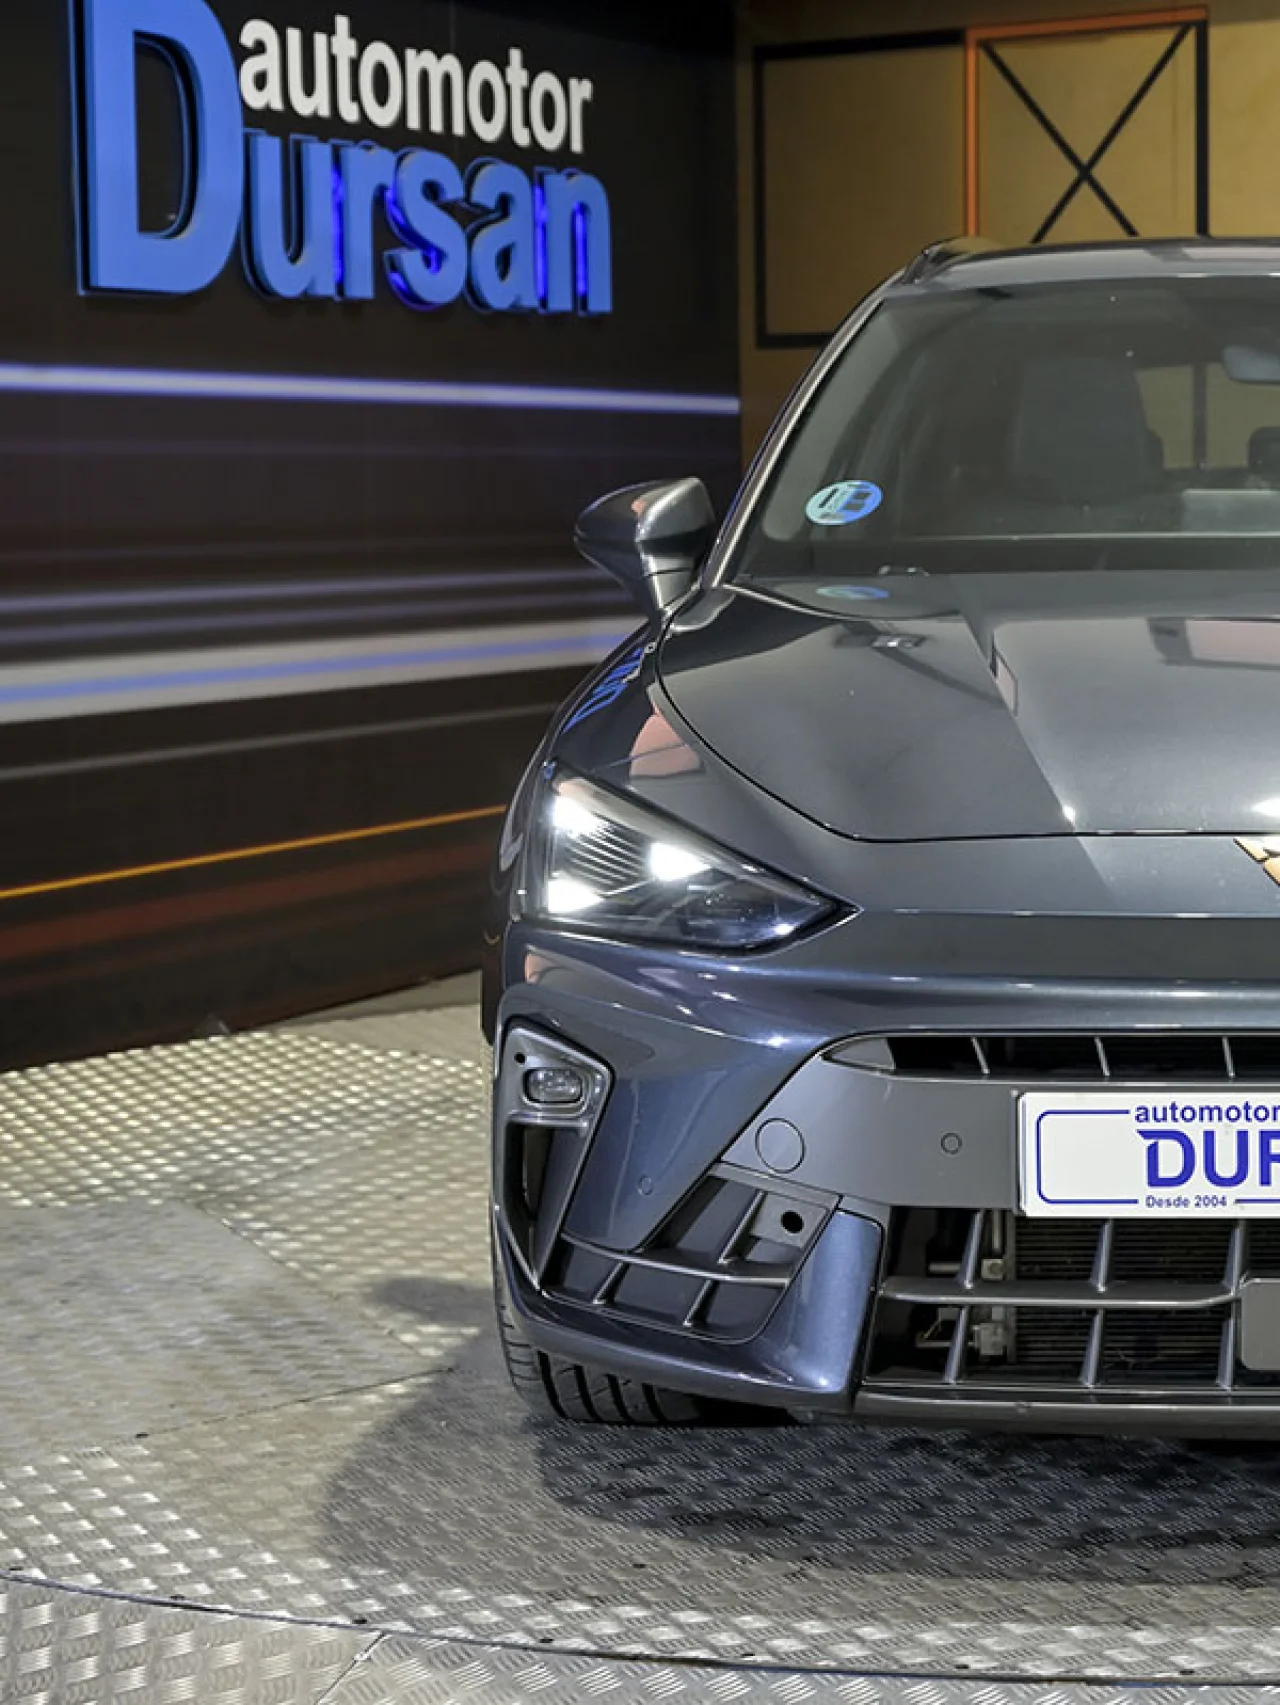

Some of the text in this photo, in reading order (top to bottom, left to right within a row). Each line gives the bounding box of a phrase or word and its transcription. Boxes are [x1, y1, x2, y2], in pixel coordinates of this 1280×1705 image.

[239, 14, 593, 154] automotor
[71, 0, 613, 315] Dursan
[1145, 1194, 1228, 1209] Desde 2004
